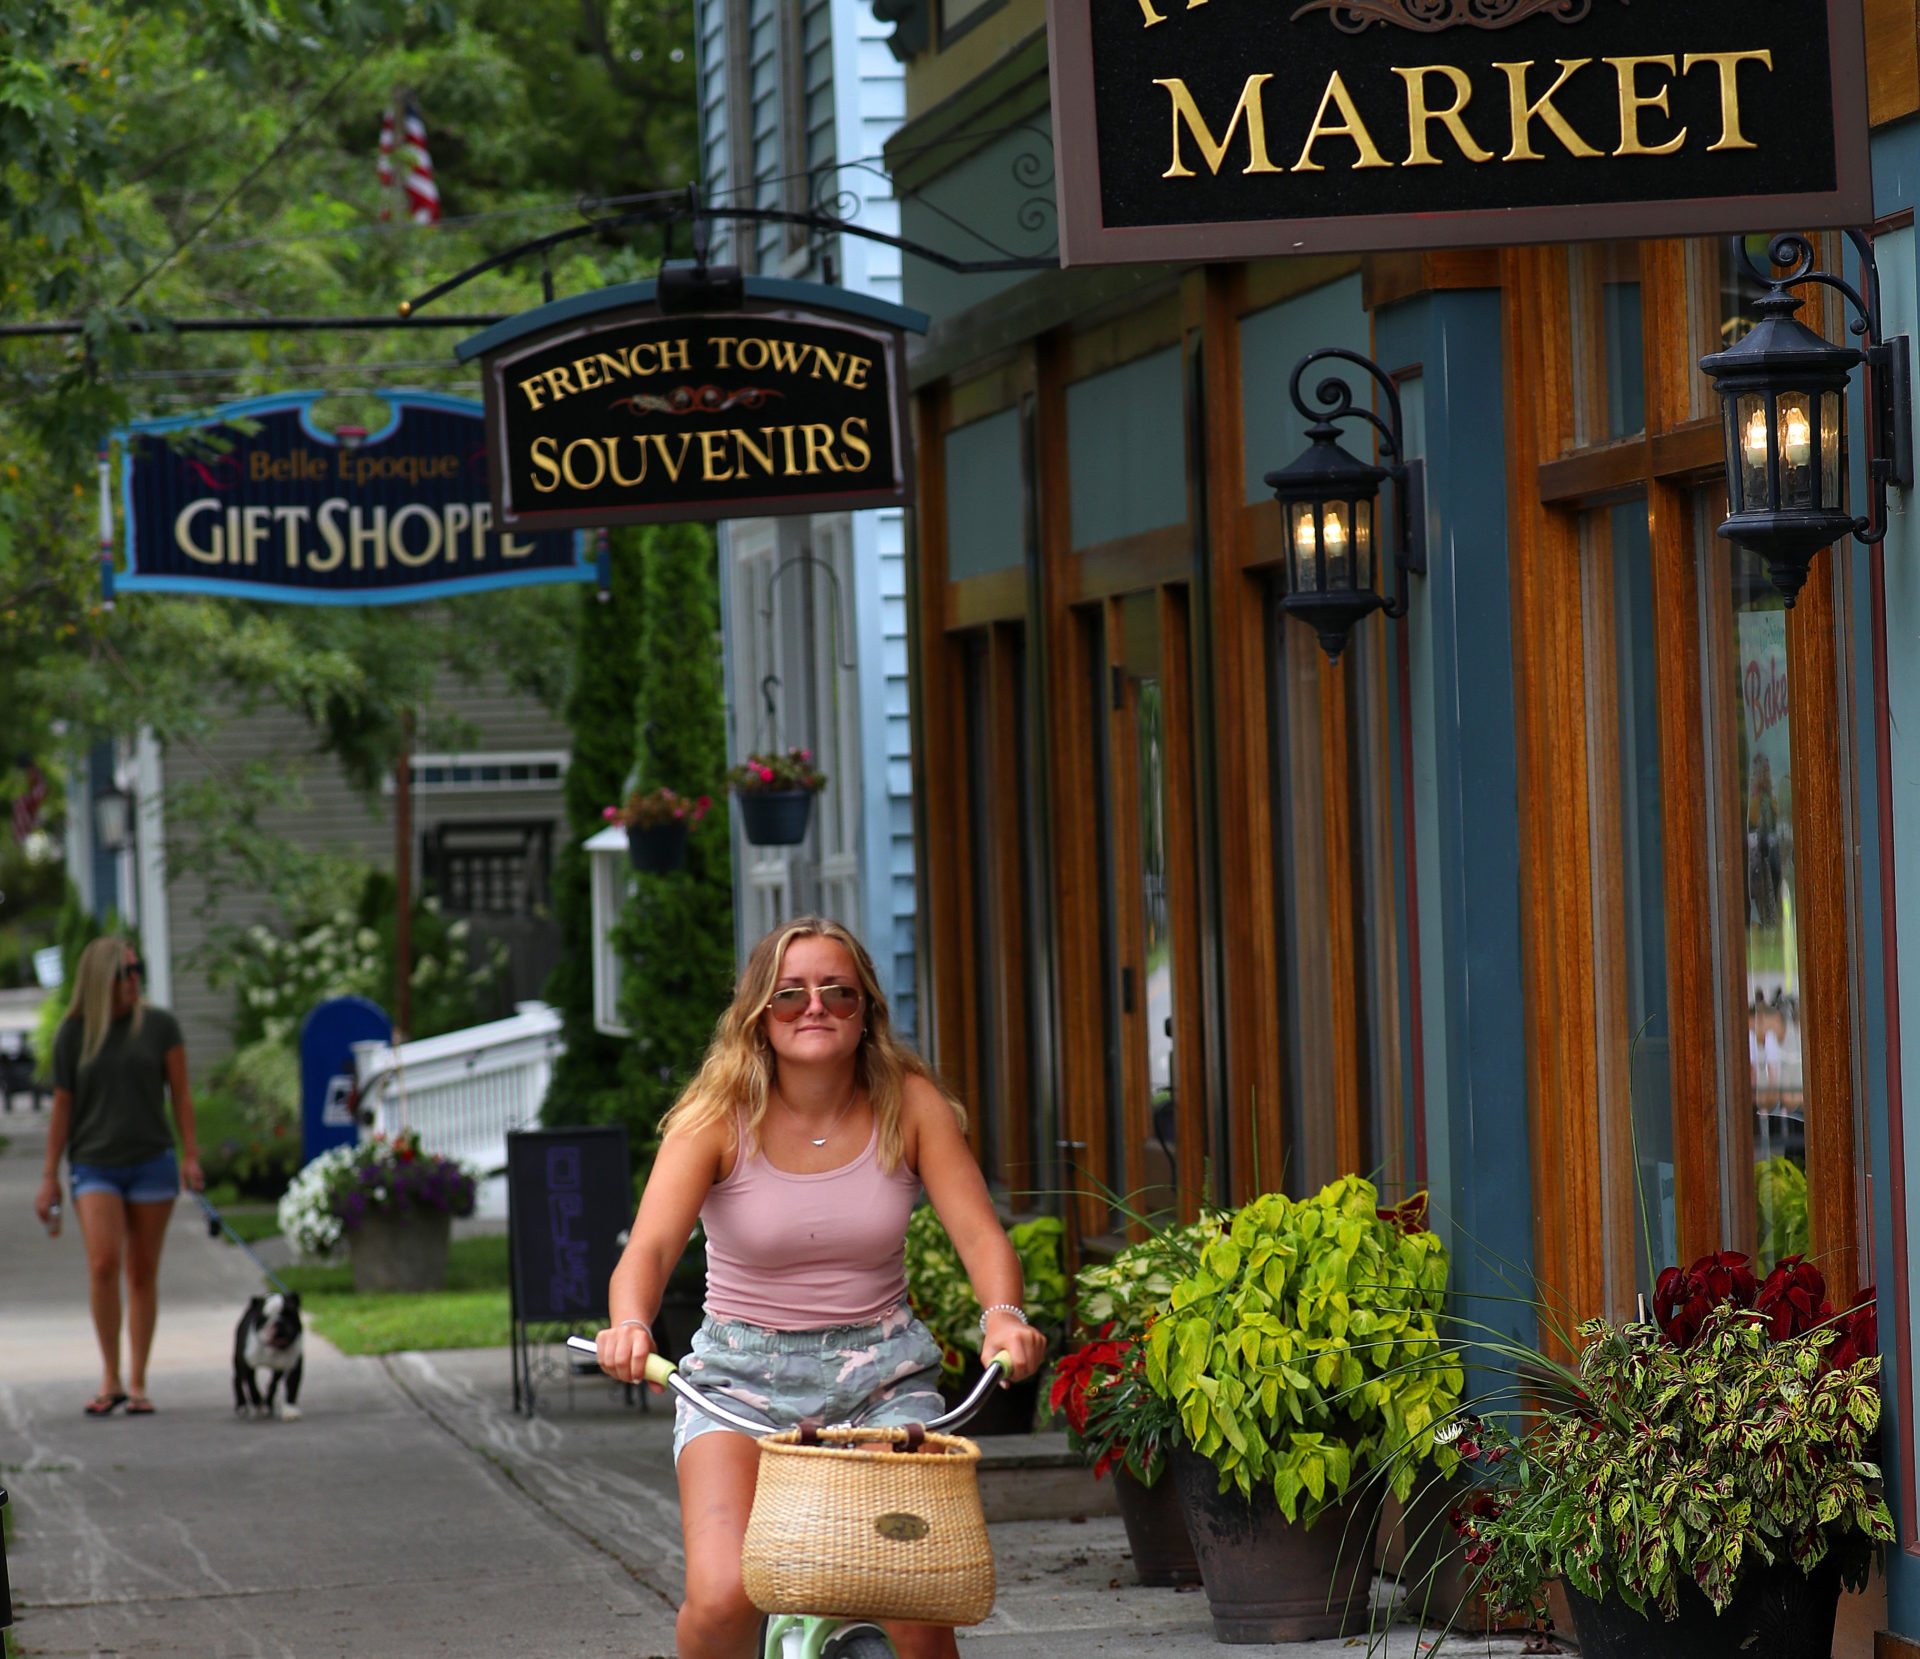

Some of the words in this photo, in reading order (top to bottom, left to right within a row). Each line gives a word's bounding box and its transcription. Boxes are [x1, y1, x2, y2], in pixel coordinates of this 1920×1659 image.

[1152, 48, 1774, 179] MARKET
[518, 338, 691, 411] FRENCH
[708, 336, 873, 390] TOWNE
[249, 449, 328, 482] Belle
[338, 451, 459, 485] Epoque
[529, 416, 872, 493] SOUVENIRS
[546, 1145, 590, 1312] OPEN
